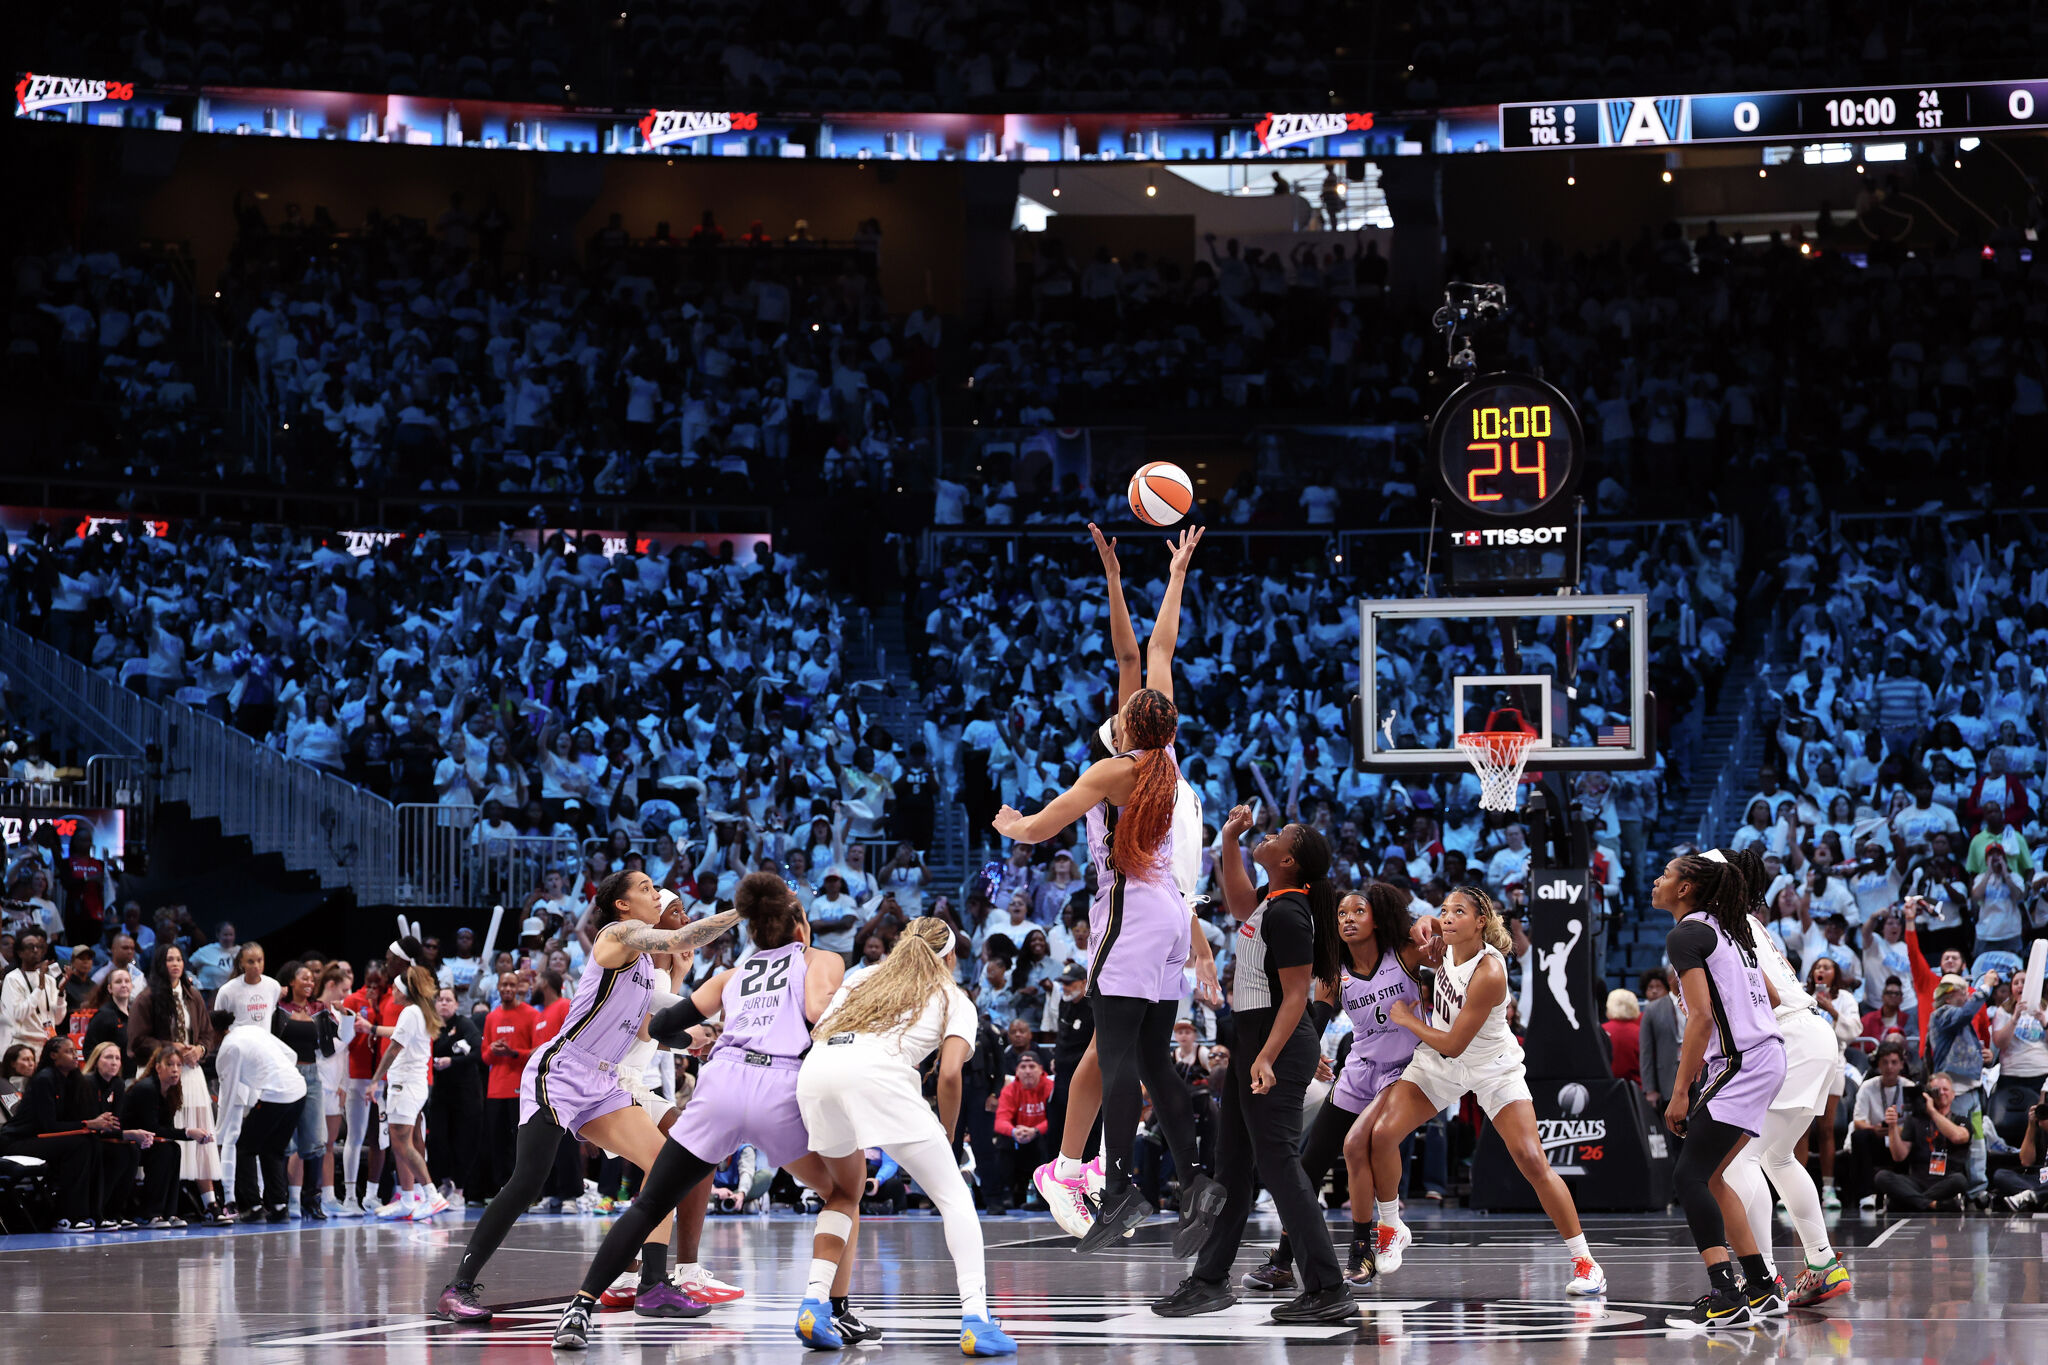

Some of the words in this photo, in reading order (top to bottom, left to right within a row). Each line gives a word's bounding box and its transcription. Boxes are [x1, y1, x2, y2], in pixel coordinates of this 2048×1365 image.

[23, 74, 107, 105] FINALS
[1918, 90, 1939, 108] 24
[1529, 107, 1556, 126] FLS
[1563, 106, 1576, 125] 0
[1733, 102, 1760, 132] 0
[1825, 96, 1896, 127] 10:00
[2008, 89, 2035, 120] 0
[649, 110, 732, 137] FINALS
[1265, 113, 1348, 141] FINALS
[1916, 110, 1943, 128] 1ST
[1529, 126, 1560, 145] TOL
[1563, 125, 1576, 144] 5
[1472, 405, 1551, 440] 10:00
[1467, 440, 1546, 502] 24
[1482, 526, 1567, 546] TISSOT
[1537, 879, 1584, 905] ally
[740, 953, 792, 997] 22
[742, 994, 780, 1011] BURTON
[1347, 992, 1377, 1011] GOLDEN
[1377, 982, 1405, 1001] STATE
[1435, 989, 1451, 1025] 00
[1375, 1005, 1388, 1025] 6
[1578, 1145, 1605, 1160] '26
